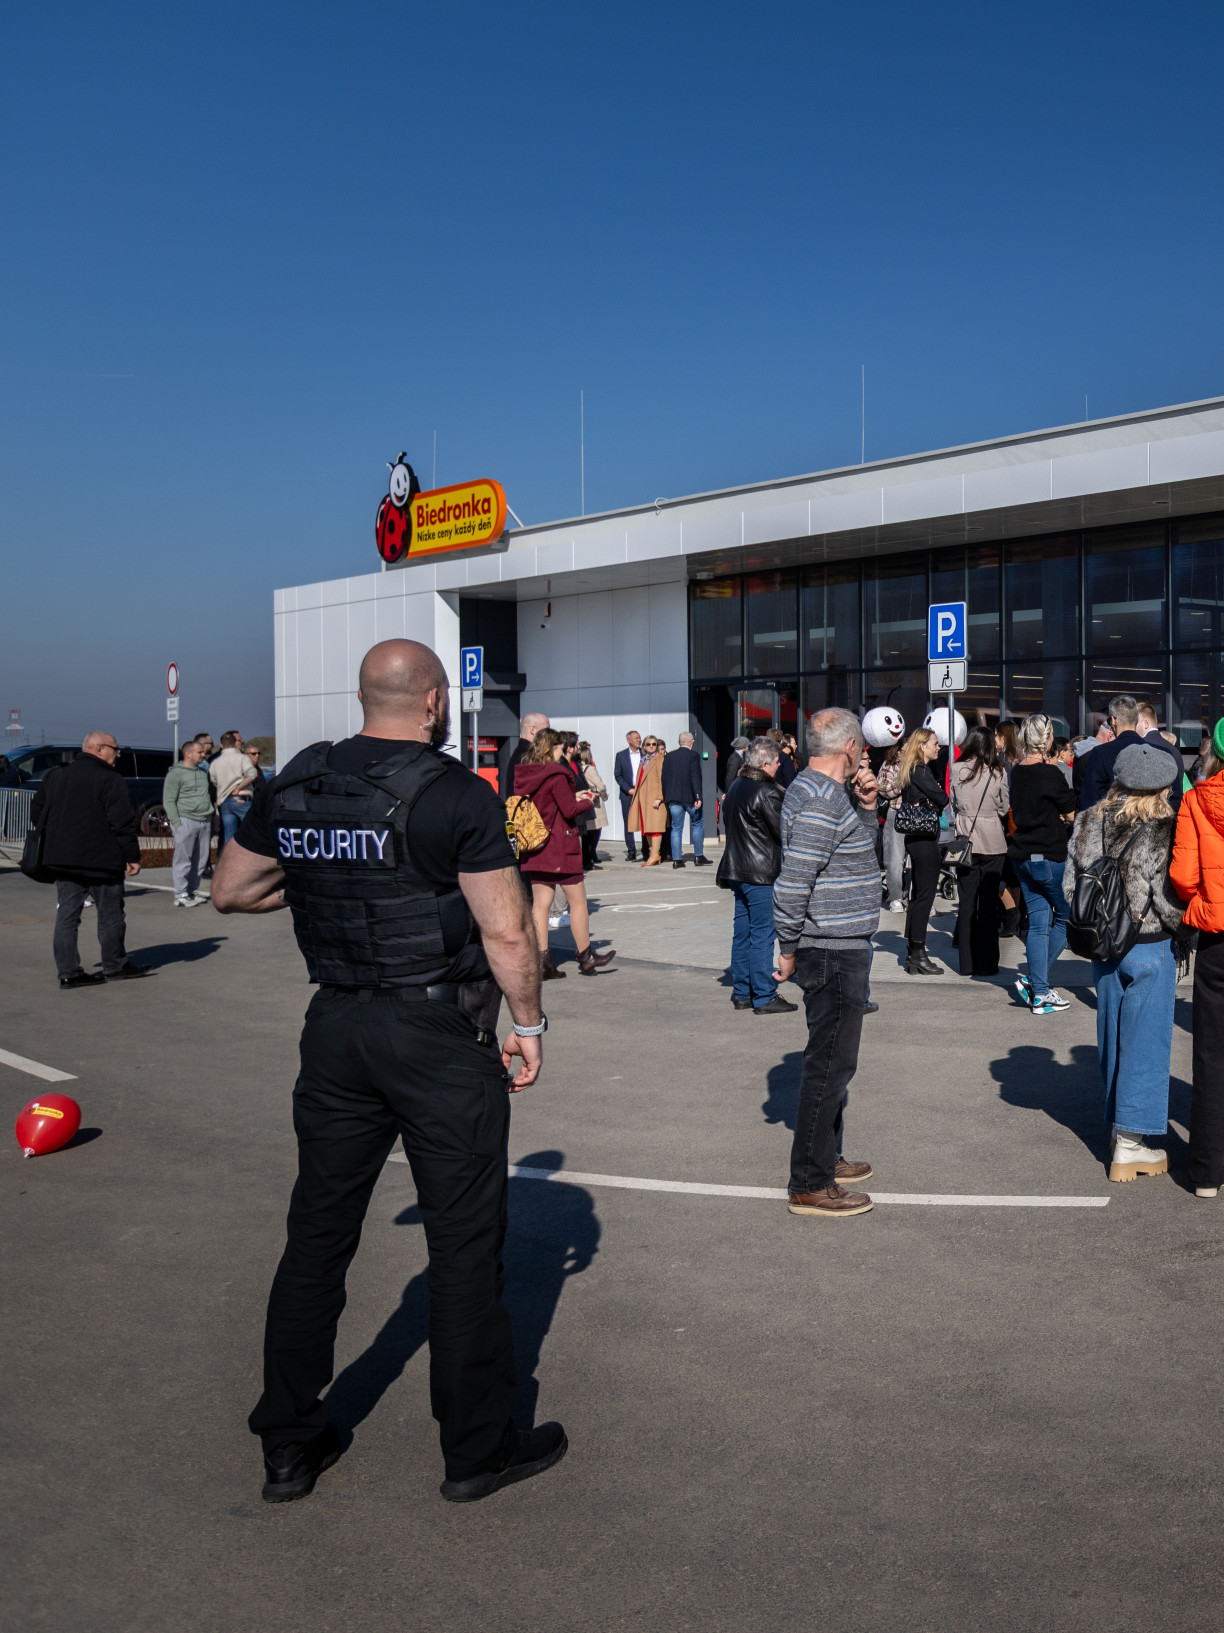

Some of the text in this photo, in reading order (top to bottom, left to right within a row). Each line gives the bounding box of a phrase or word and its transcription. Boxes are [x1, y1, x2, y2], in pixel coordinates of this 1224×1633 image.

[417, 493, 491, 528] Biedronka
[417, 517, 492, 542] Nízke ceny každý deň
[937, 611, 957, 653] P
[466, 653, 477, 683] P
[278, 827, 389, 860] SECURITY
